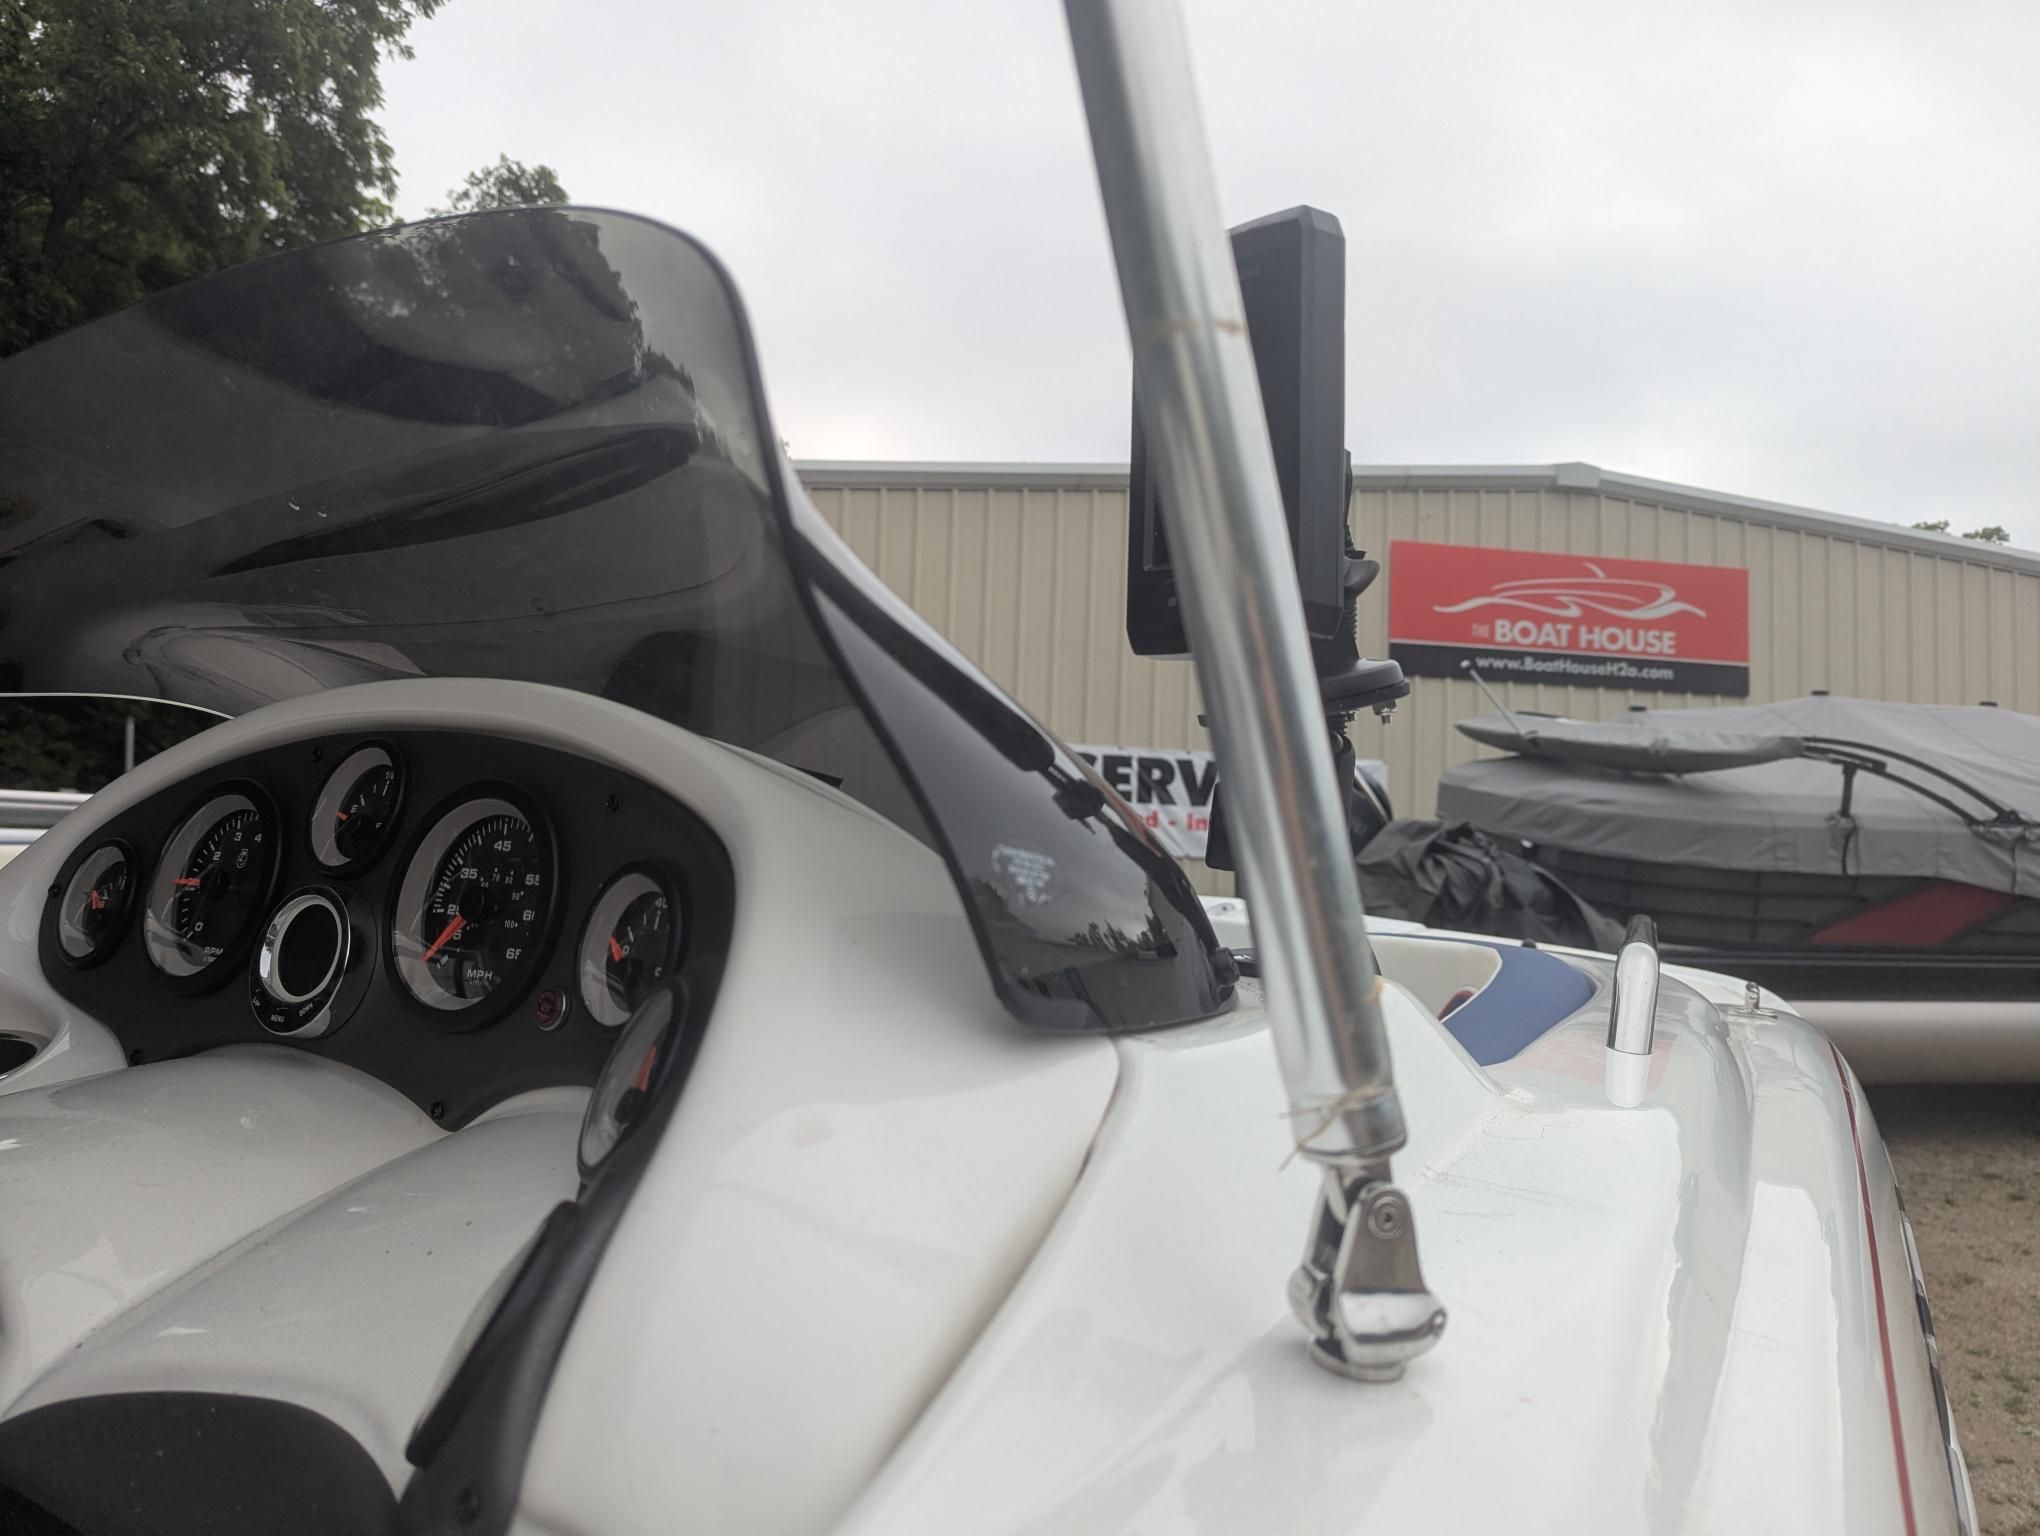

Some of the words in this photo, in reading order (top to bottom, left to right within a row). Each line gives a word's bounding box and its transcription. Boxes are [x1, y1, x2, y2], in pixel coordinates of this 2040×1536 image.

[1471, 623, 1489, 638] THE
[1494, 618, 1572, 648] BOAT
[1578, 625, 1676, 654] HOUSE
[1475, 656, 1674, 680] www.BoatHouseH2o.com
[234, 832, 243, 842] 3
[254, 833, 262, 843] 4
[494, 840, 512, 852] 45
[212, 851, 221, 861] 2
[460, 867, 478, 879] 35
[203, 946, 224, 956] RPM
[466, 968, 493, 980] MPH
[298, 1002, 313, 1017] DOWN
[270, 1013, 285, 1023] MENU
